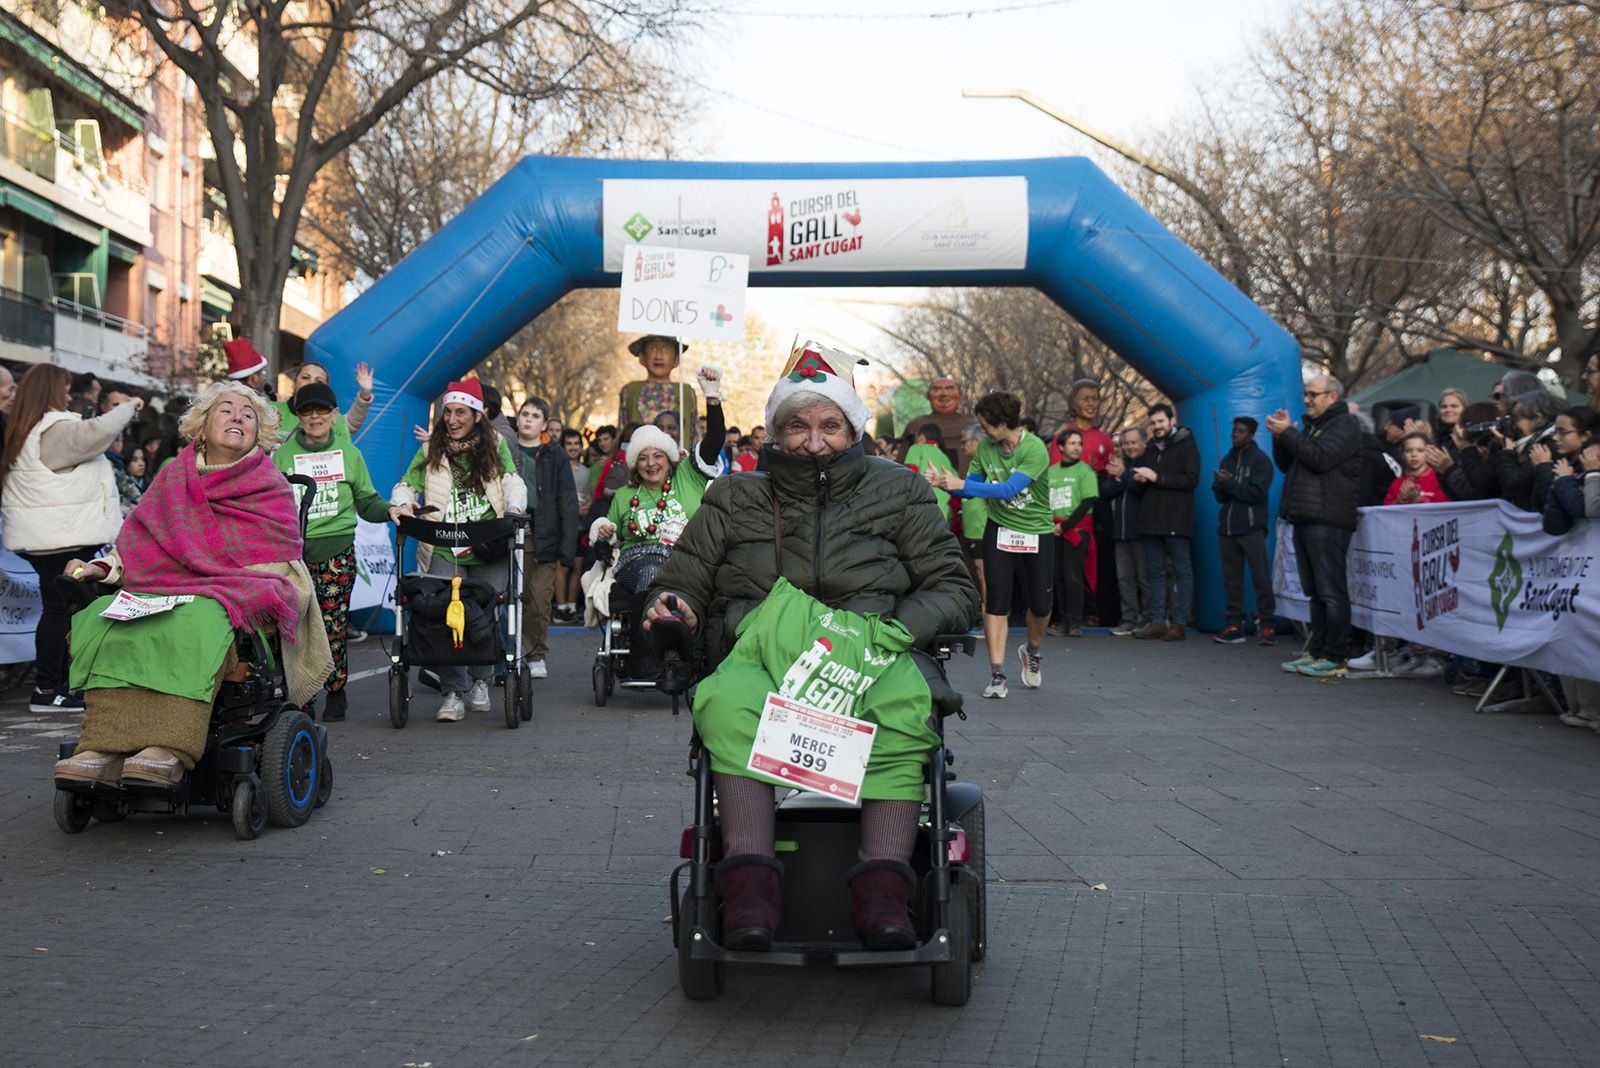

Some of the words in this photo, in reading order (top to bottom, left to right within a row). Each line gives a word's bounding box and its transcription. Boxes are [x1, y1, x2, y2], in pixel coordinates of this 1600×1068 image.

[790, 195, 833, 218] CURSA
[837, 190, 859, 209] DEL
[791, 213, 843, 246] GALL
[788, 243, 821, 263] SANT
[824, 236, 863, 256] CUGAT
[644, 261, 667, 274] GALL
[632, 297, 698, 325] DONES
[435, 529, 469, 539] KMINA
[1422, 524, 1445, 557] CURSA
[1446, 517, 1460, 546] DEL
[1422, 551, 1448, 596] GALL
[789, 732, 837, 758] MERCE
[789, 750, 828, 773] 399
